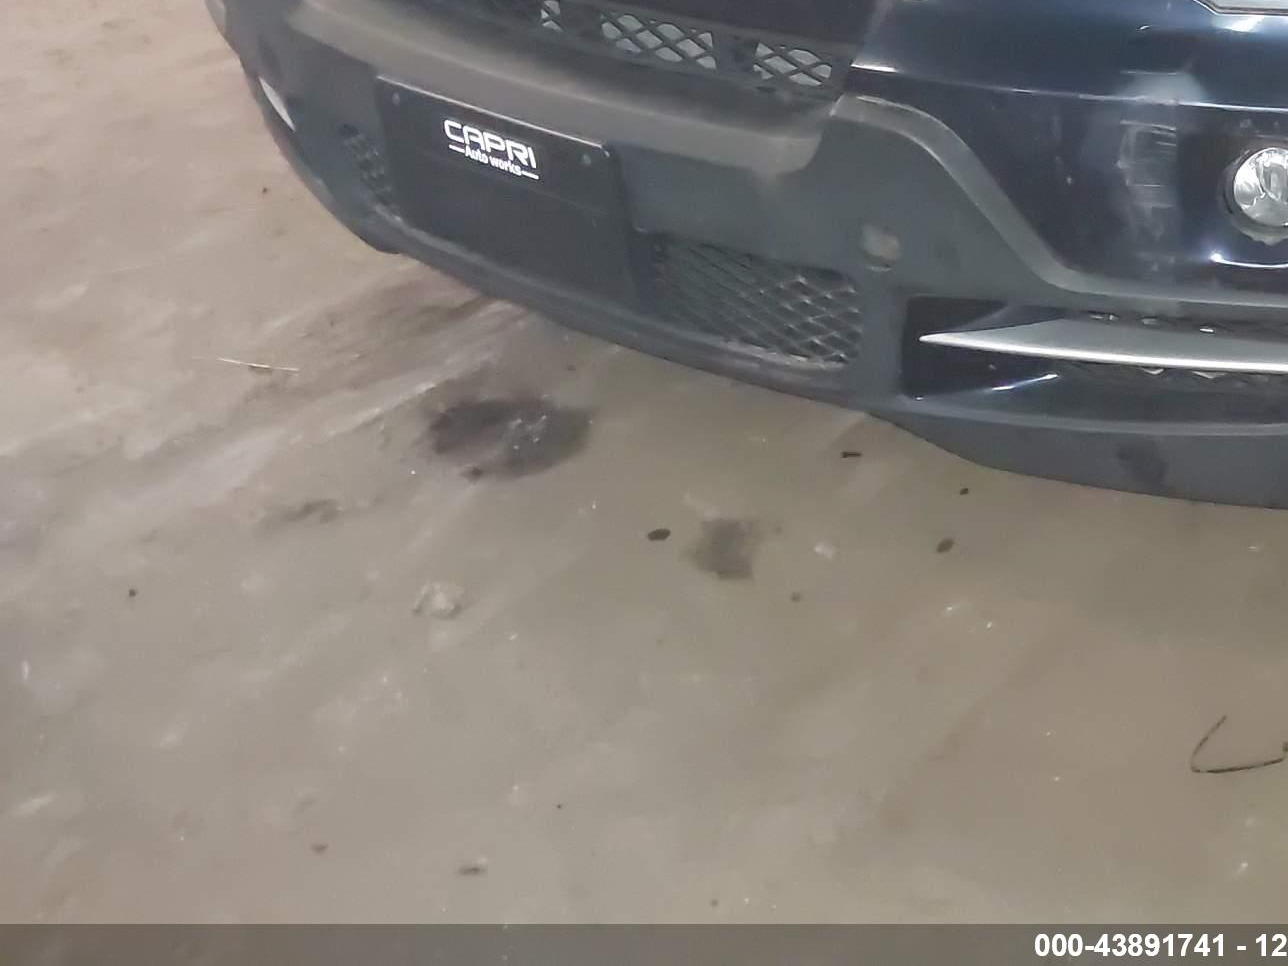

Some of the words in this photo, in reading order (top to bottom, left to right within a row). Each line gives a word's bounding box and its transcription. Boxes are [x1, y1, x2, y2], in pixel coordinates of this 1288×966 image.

[444, 119, 537, 169] CAPRI
[464, 144, 489, 164] Auto
[489, 154, 523, 176] works
